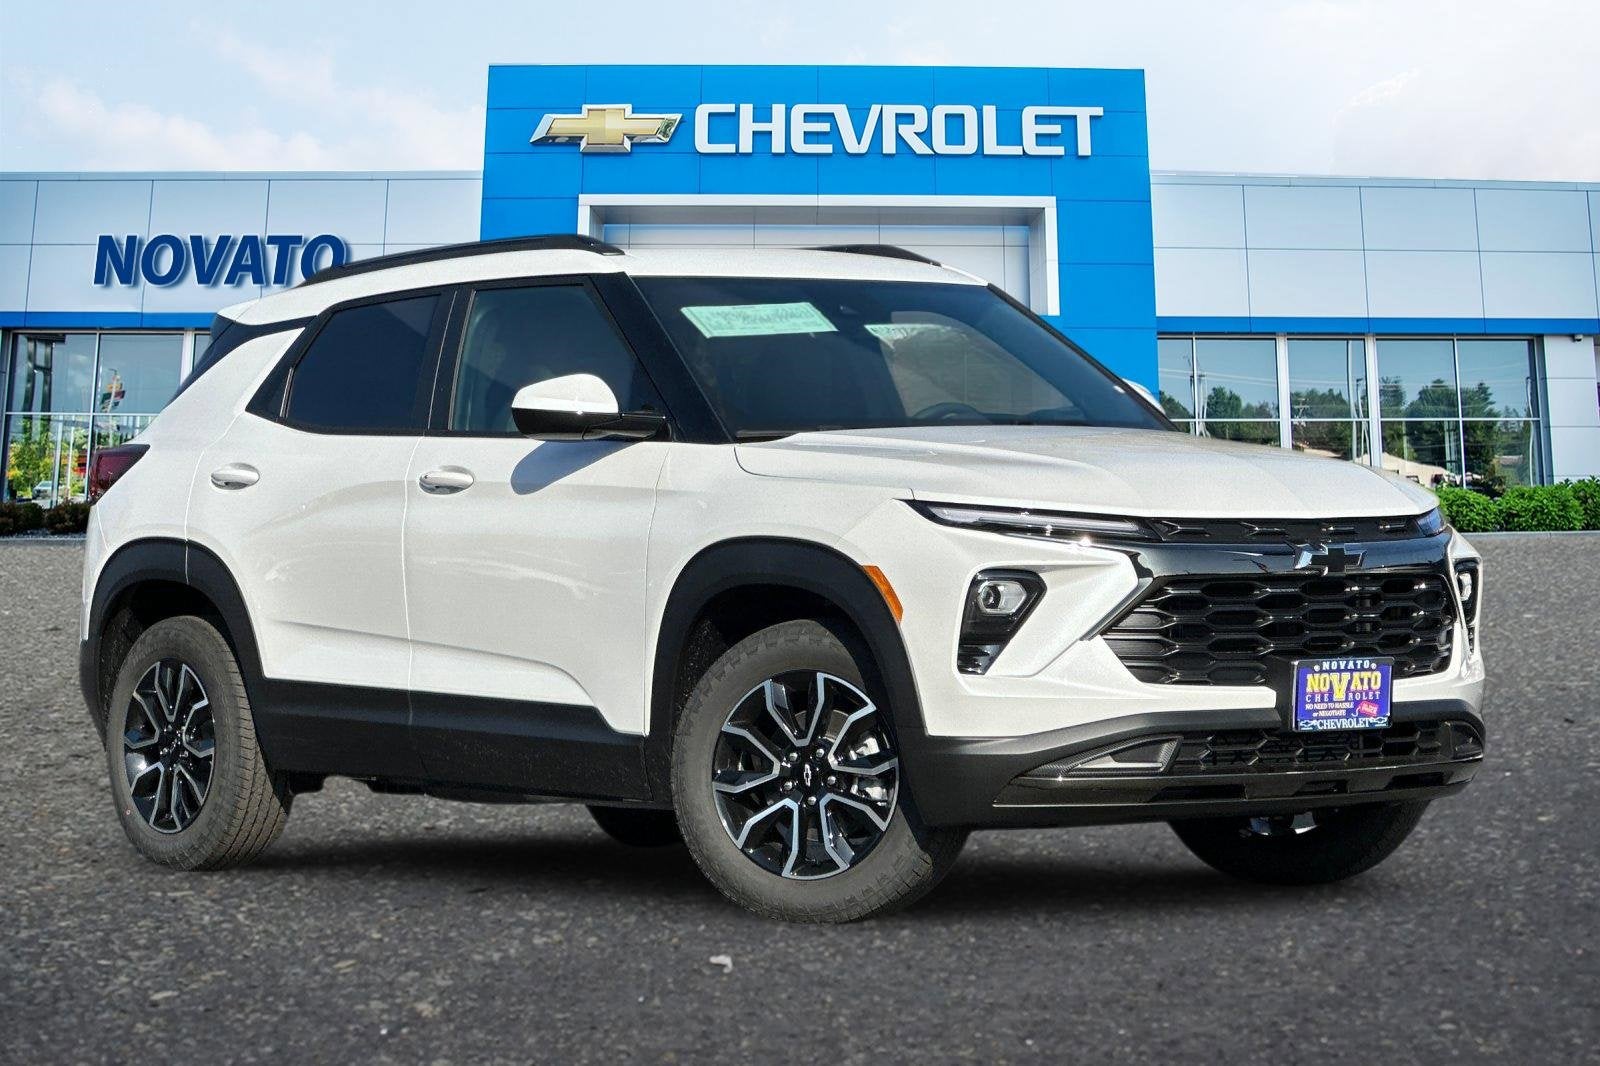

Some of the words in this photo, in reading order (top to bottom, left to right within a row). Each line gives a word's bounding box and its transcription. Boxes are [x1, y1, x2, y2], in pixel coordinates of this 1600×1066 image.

[694, 103, 1104, 157] CHEVROLET
[93, 234, 346, 286] NOVATO
[1322, 660, 1370, 670] NOVATO
[1306, 671, 1382, 701] NOVATO
[1314, 702, 1328, 710] NEED
[1335, 701, 1354, 709] HASSLE
[1319, 709, 1347, 717] NEGOTIATE
[1317, 717, 1370, 729] CHEVROLET
